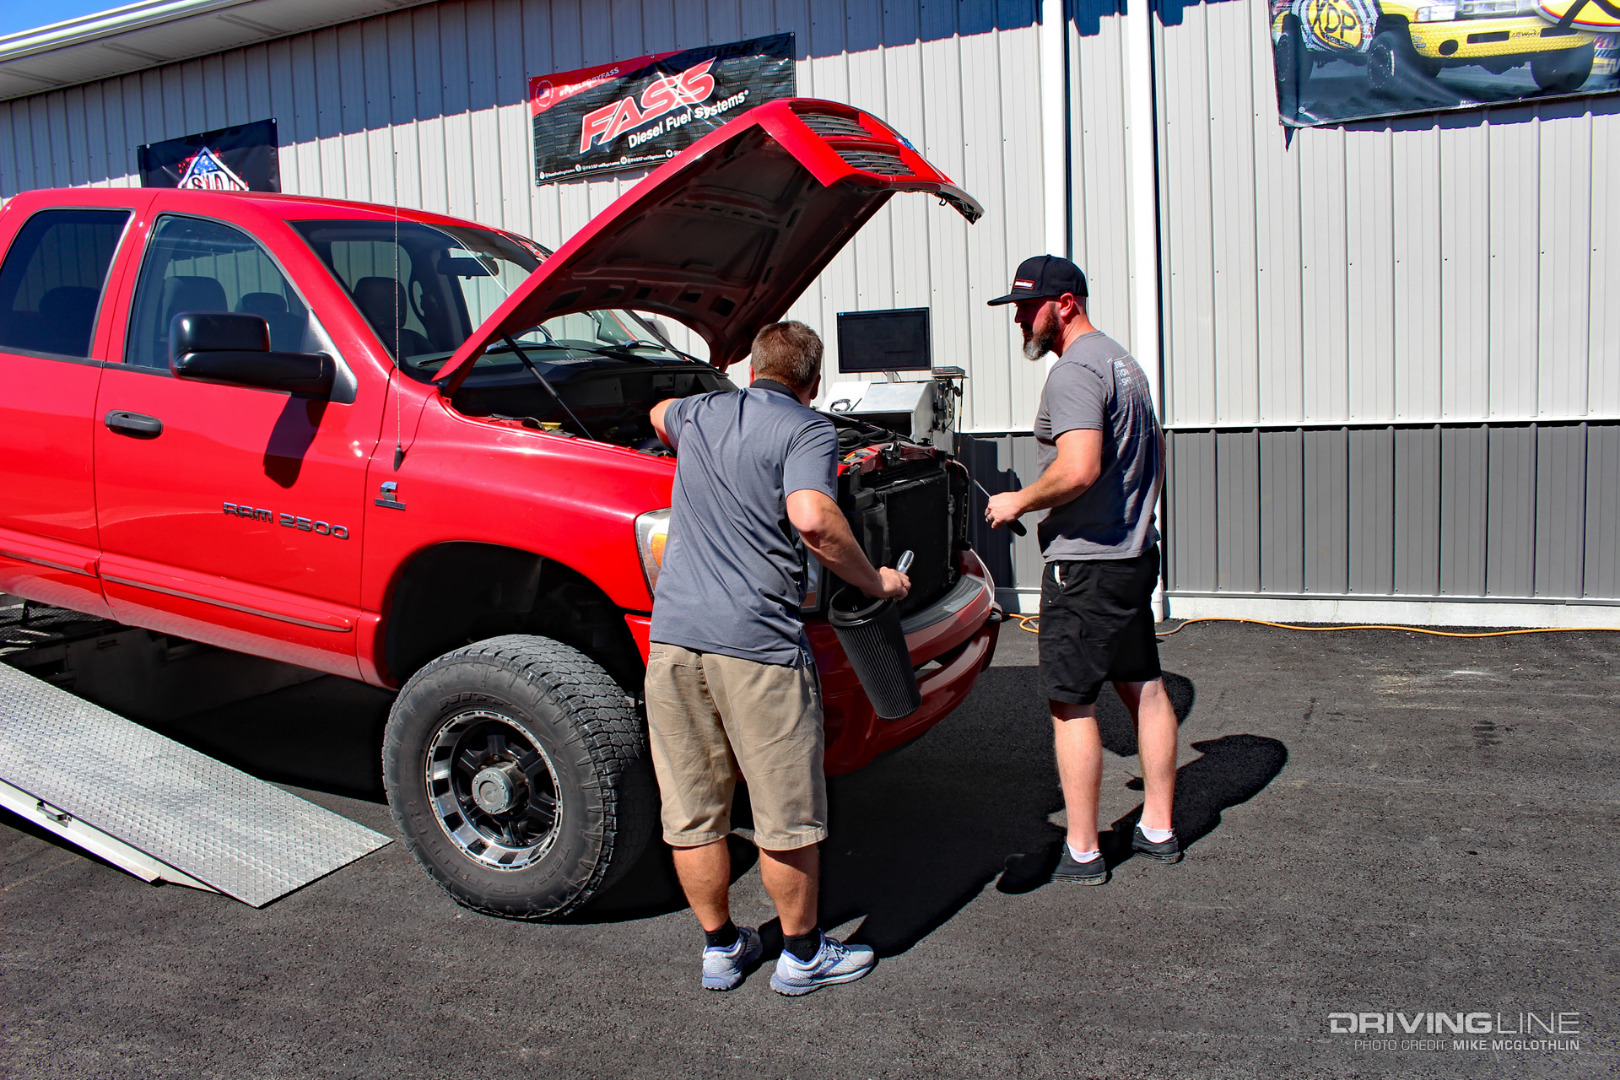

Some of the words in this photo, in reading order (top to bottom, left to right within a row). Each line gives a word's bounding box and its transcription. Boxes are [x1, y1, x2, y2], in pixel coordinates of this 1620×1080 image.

[580, 56, 717, 154] FASS
[628, 121, 664, 149] Diesel
[666, 108, 692, 131] Fuel
[223, 501, 273, 524] RAM
[279, 512, 349, 540] 2500
